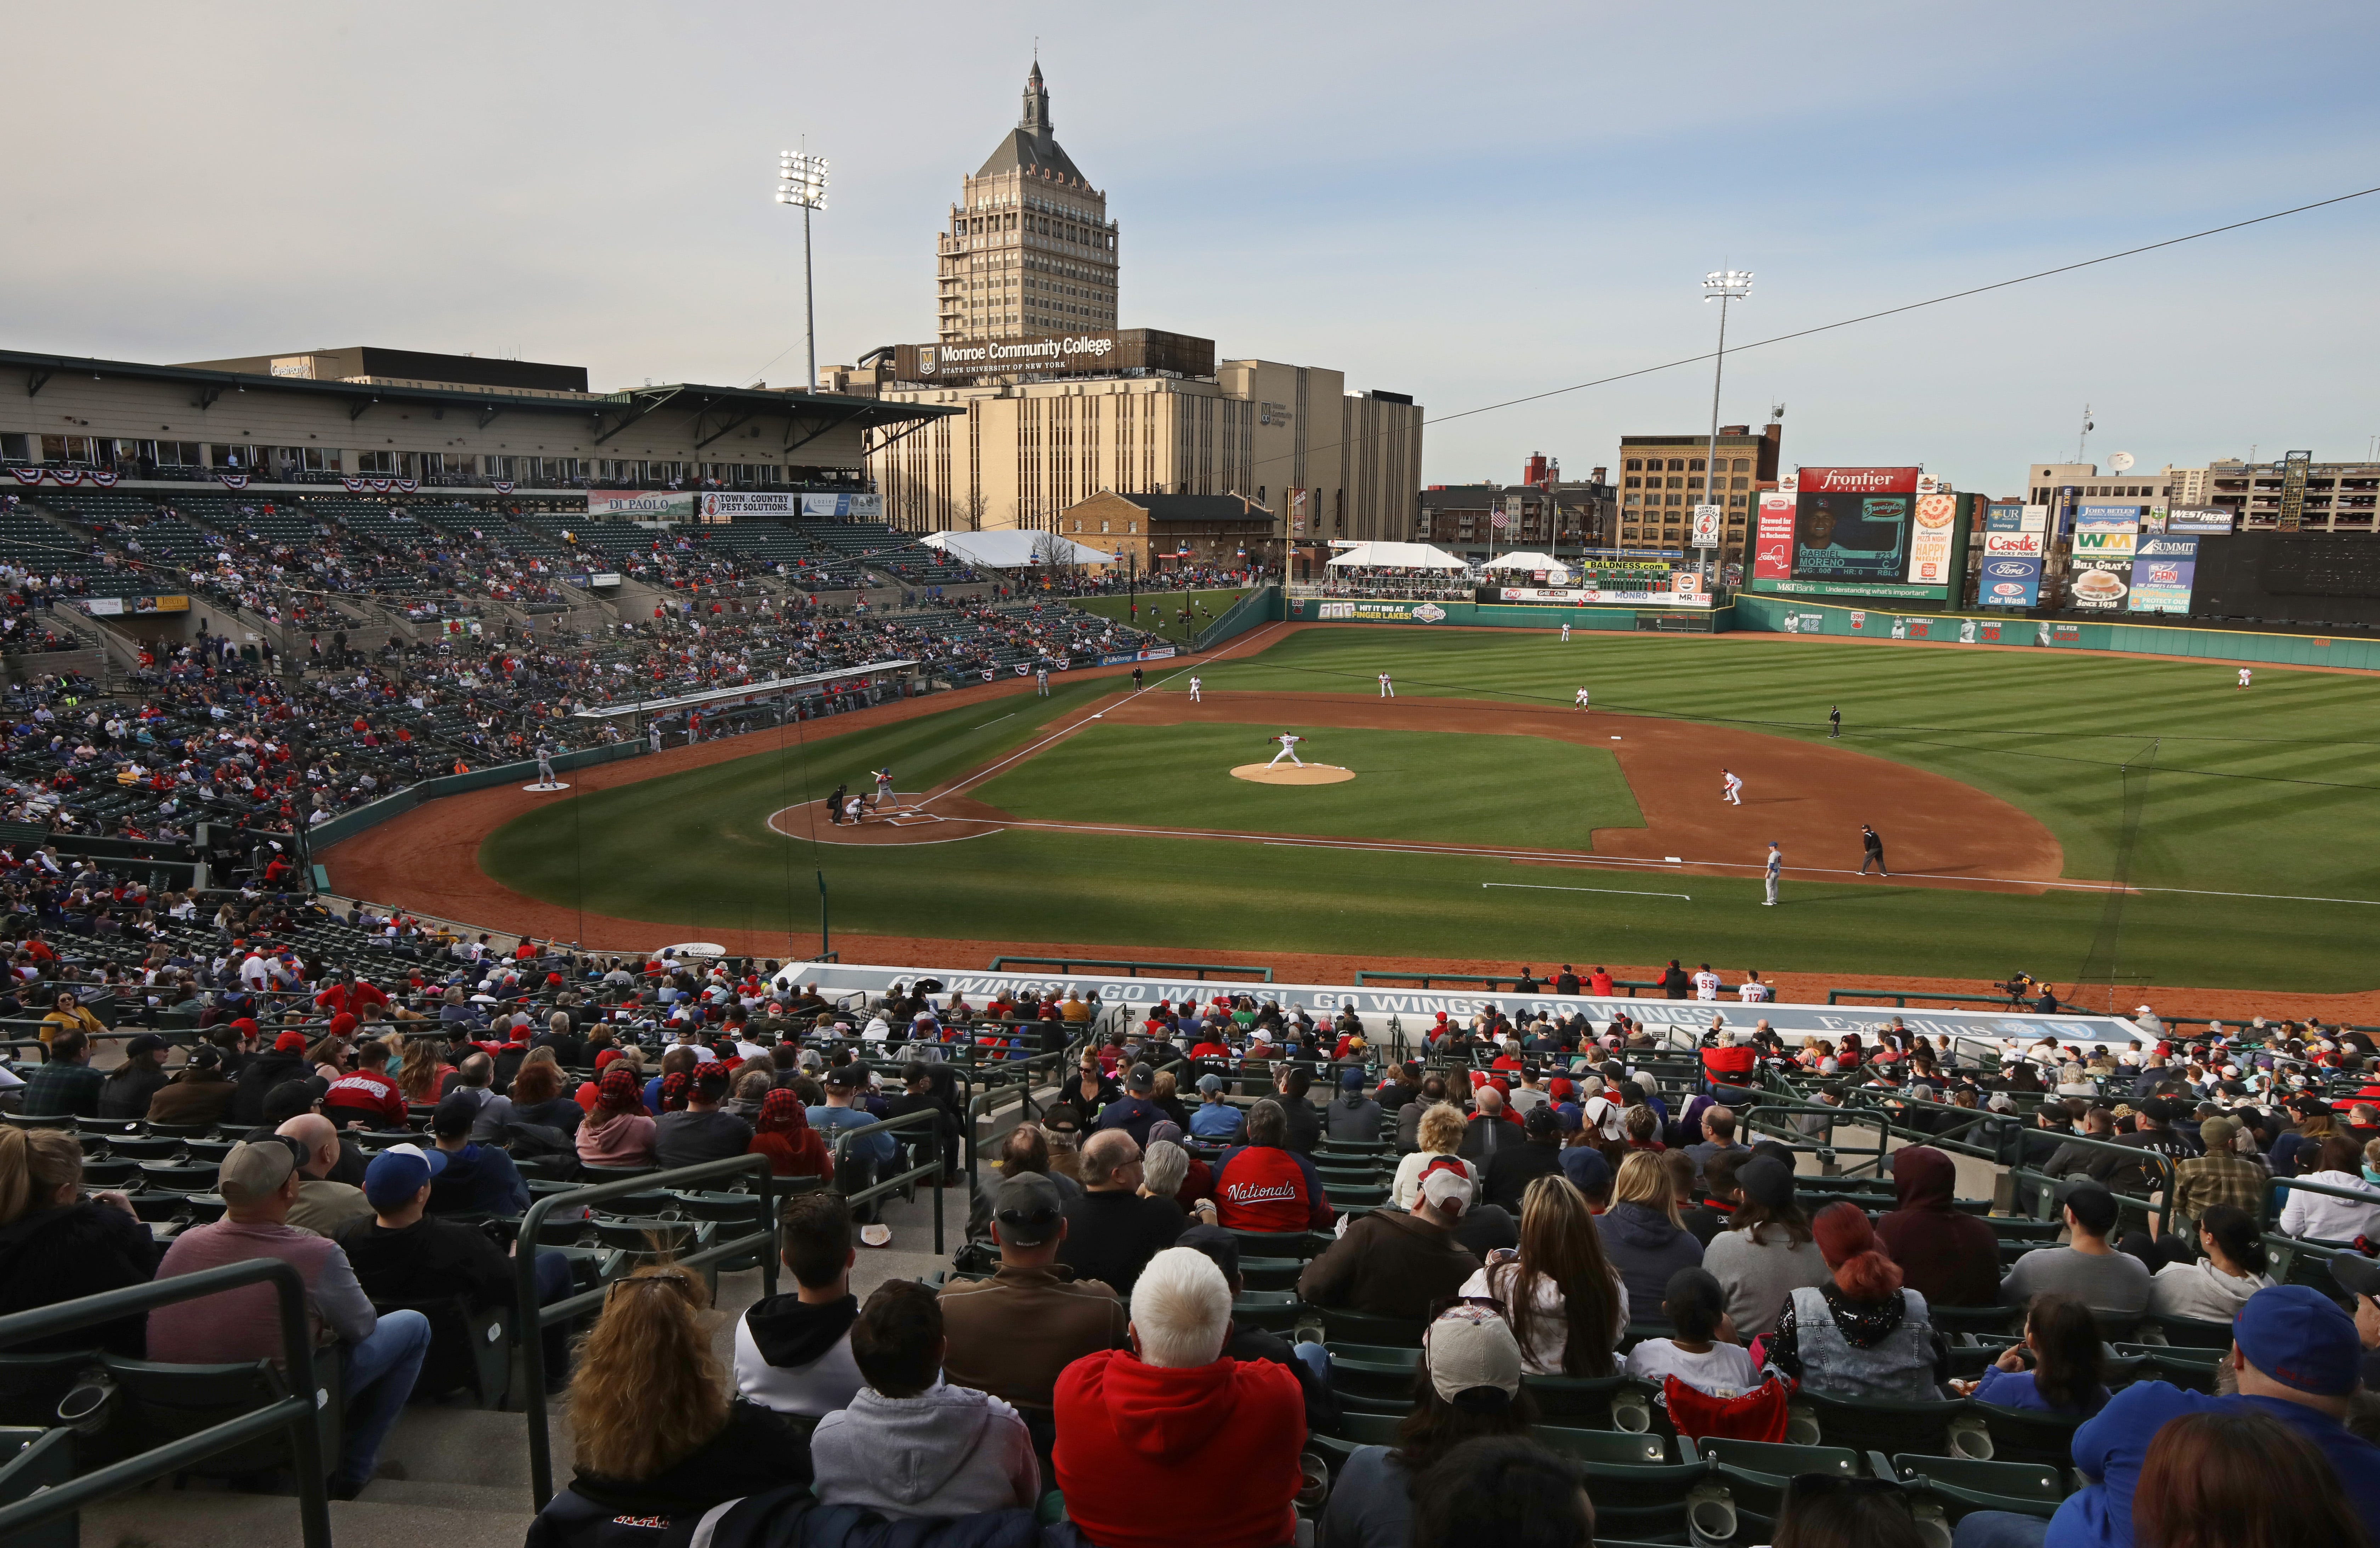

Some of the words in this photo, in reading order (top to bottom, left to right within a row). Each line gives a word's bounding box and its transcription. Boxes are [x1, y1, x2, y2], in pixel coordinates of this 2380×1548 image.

[942, 346, 985, 362] Monroe
[989, 339, 1061, 358] Community
[1063, 336, 1111, 356] College
[923, 353, 932, 363] M
[271, 365, 302, 376] Carestream
[1263, 404, 1269, 414] M
[1271, 401, 1286, 410] Monroe
[1271, 410, 1293, 419] Community
[1271, 418, 1286, 427] College
[1820, 470, 1894, 489] frontier
[609, 499, 623, 509] DI
[628, 499, 669, 509] PAOLO
[1862, 503, 1903, 518] Zweigle's
[2003, 509, 2019, 518] UR
[2082, 507, 2105, 516] JOHN
[1989, 533, 2038, 551] Castle
[2078, 534, 2131, 548] WM
[1916, 543, 1946, 556] HAPPY
[2153, 543, 2195, 552] SUMMIT
[1800, 558, 1844, 566] MORENO
[2072, 560, 2094, 569] BILL
[2096, 560, 2131, 570] GRAY'S
[1996, 564, 2025, 574] Ford
[2154, 571, 2177, 581] FAN
[1826, 586, 1870, 595] Understanding
[162, 597, 182, 606] JESUIT
[1413, 608, 1429, 617] FINGER
[1430, 609, 1444, 619] LAKES
[1802, 619, 1819, 631] 42
[1909, 624, 1928, 637] 26
[1980, 628, 2000, 640] 36
[2053, 632, 2079, 641] 8,222
[753, 691, 779, 700] Firestone
[710, 697, 740, 707] Firestone
[946, 977, 1075, 998] WINGS!
[1701, 979, 1714, 989] 55
[1099, 984, 1146, 1000] GO
[1313, 993, 1359, 1009] GO
[1749, 993, 1760, 1002] 17
[1531, 1001, 1581, 1019] GO
[1589, 1004, 1729, 1026] WINGS!
[339, 1077, 390, 1099] WINGS
[2144, 1143, 2188, 1157] CRAZY
[1227, 1180, 1295, 1204] Nationals
